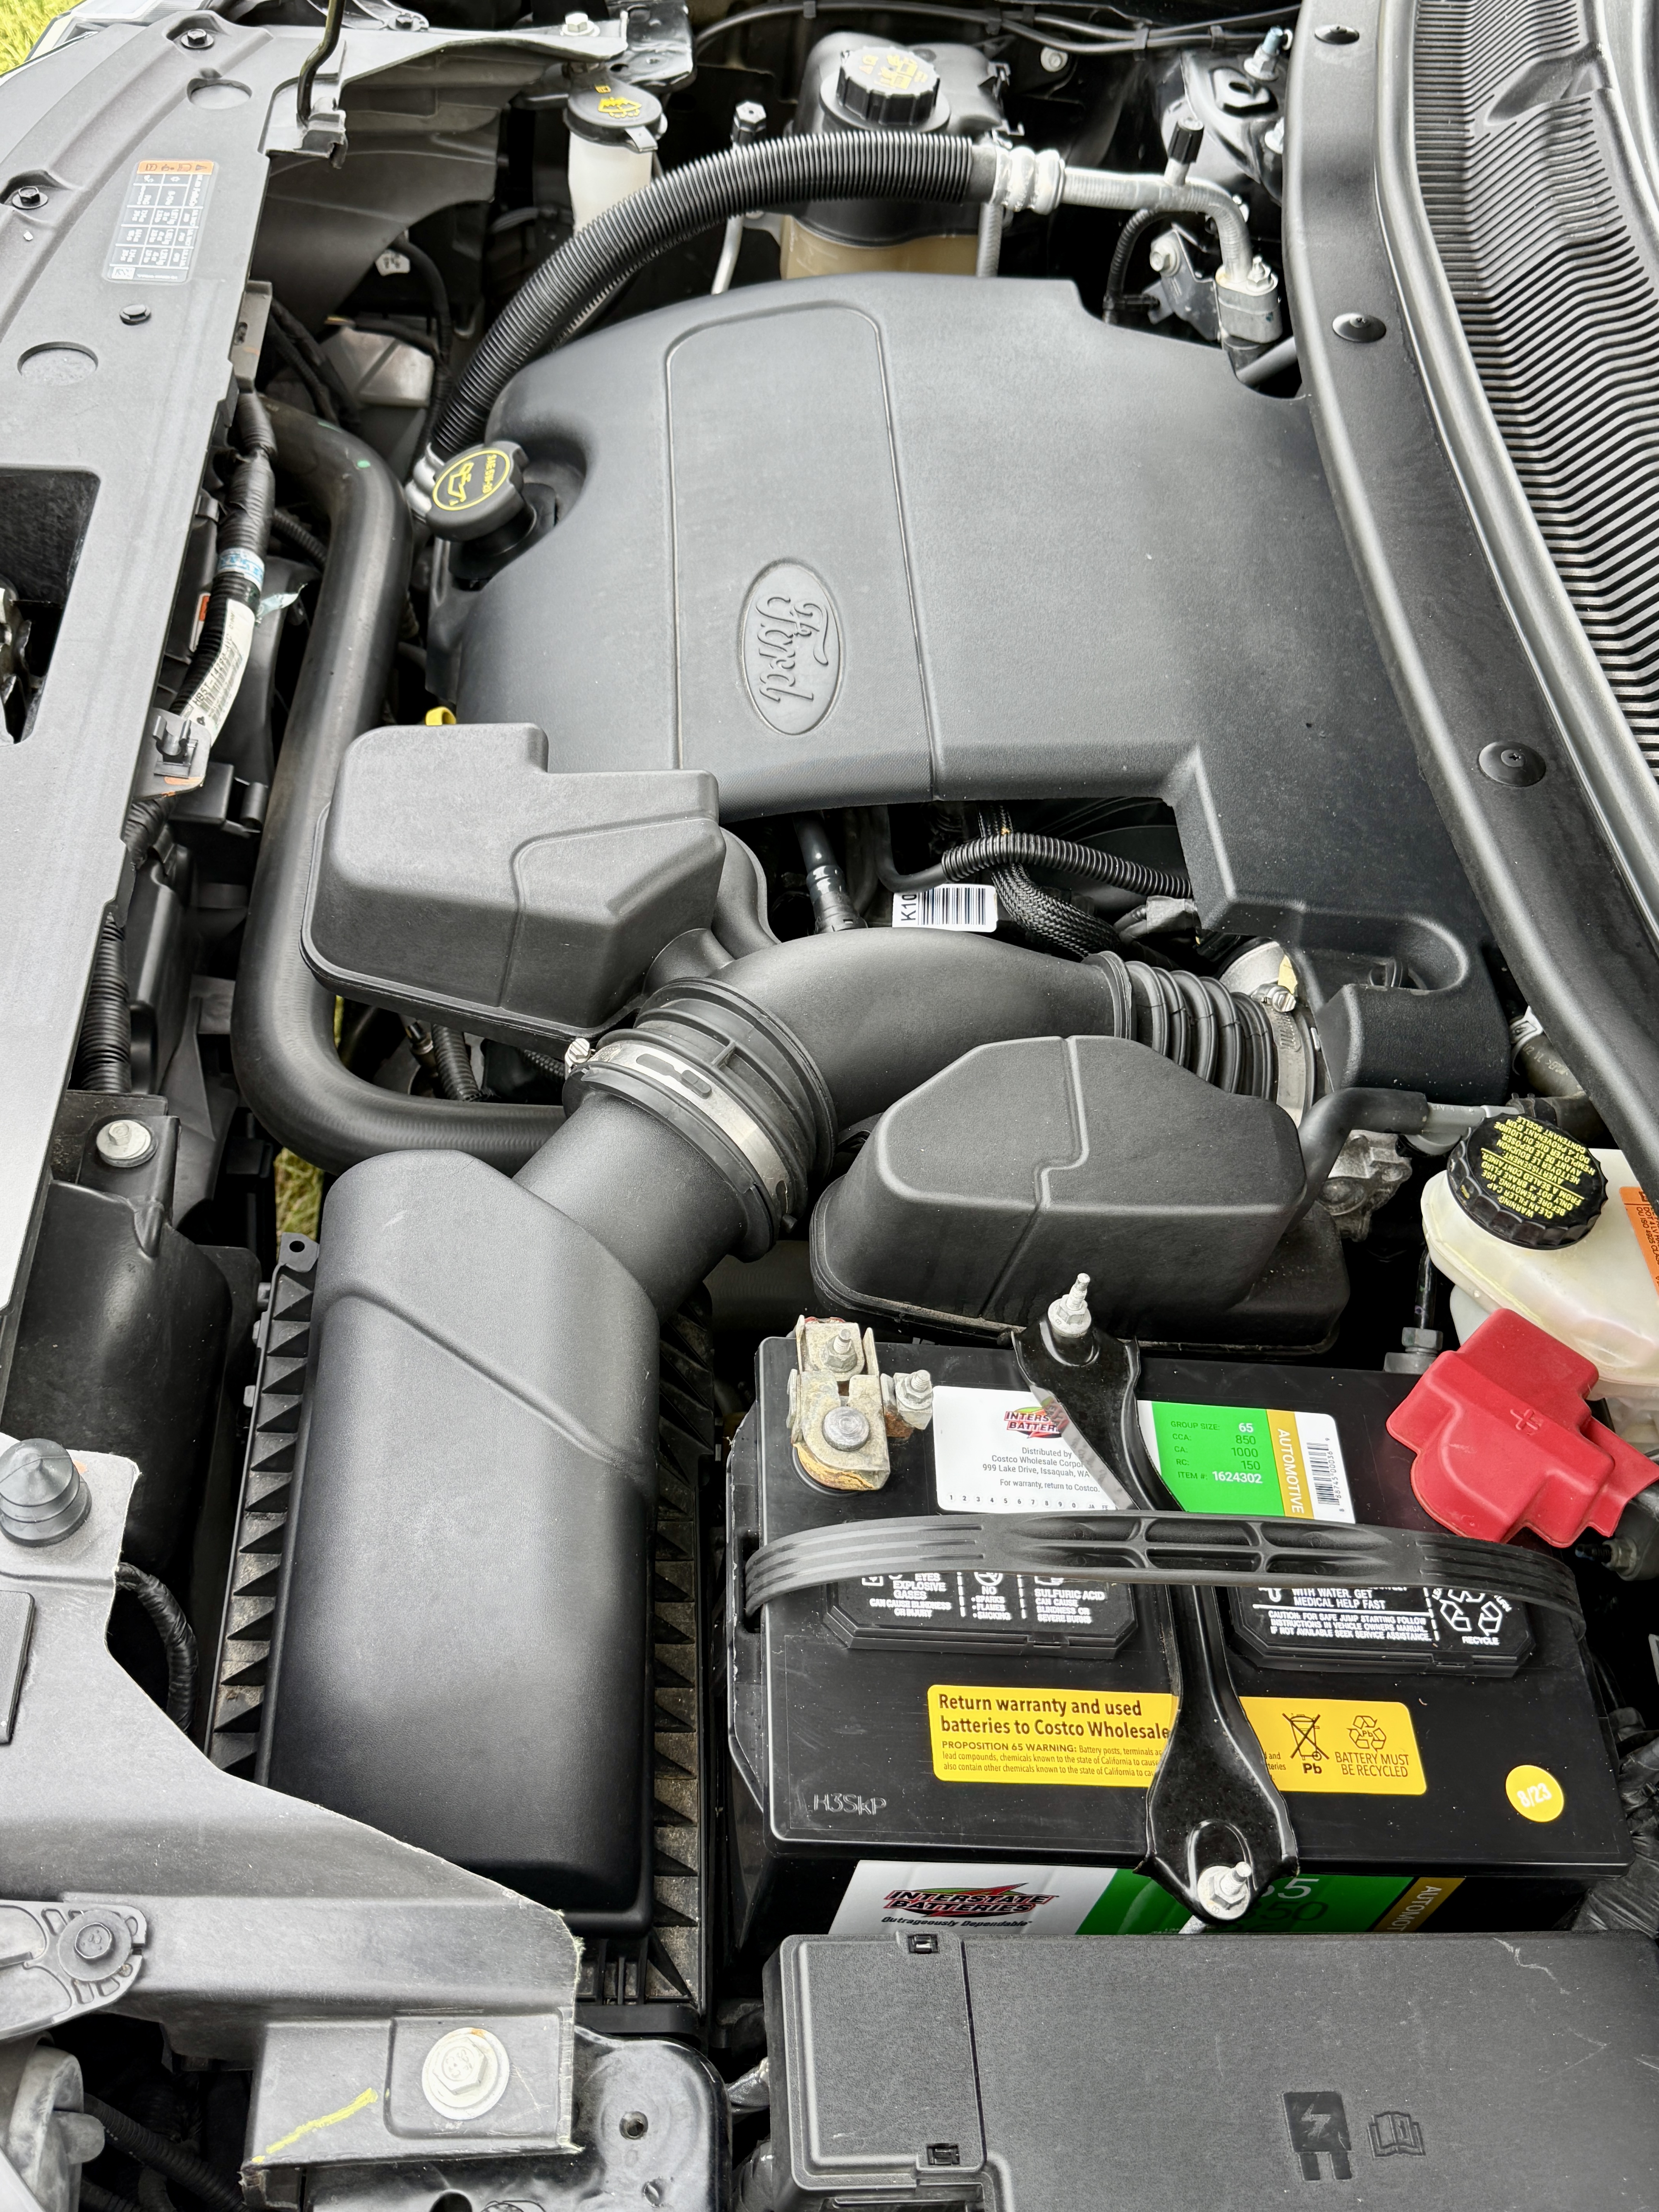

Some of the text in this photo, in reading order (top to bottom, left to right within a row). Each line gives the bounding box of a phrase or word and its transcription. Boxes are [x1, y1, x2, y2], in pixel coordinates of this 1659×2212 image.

[755, 596, 829, 703] Ford
[1494, 1121, 1523, 1139] LIQUIDE
[1516, 1116, 1586, 1154] CONTENANT SCELLE
[1523, 1135, 1534, 1145] DU
[1523, 1128, 1568, 1153] PROVENANT
[1534, 1140, 1550, 1152] QUE
[1501, 1132, 1582, 1176] AVANT DE LE DEPOSER.
[1574, 1152, 1590, 1164] DOT
[1481, 1161, 1503, 1176] FLUID
[1482, 1151, 1523, 1177] CONTAINER.
[1496, 1139, 1580, 1185] NETTOYER LE BOUCHON
[1502, 1151, 1564, 1185] AVERTISSEMENT:
[1481, 1170, 1497, 1182] USE
[1503, 1171, 1528, 1188] BRAKE
[1523, 1173, 1551, 1191] SEALED
[1487, 1183, 1553, 1219] CLEAN FILLER CAP
[1536, 1189, 1554, 1200] DOT
[1558, 1190, 1582, 1206] FROM
[1537, 1197, 1566, 1216] BEFORE
[1553, 1197, 1573, 1211] ONLY
[1643, 1207, 1654, 1219] DOT
[1636, 1207, 1656, 1244] OU ISO 4925
[1006, 1411, 1050, 1422] INTERS
[1008, 1422, 1058, 1432] BATTER
[1238, 1423, 1254, 1433] 65
[1235, 1435, 1256, 1445] 850
[1022, 1447, 1072, 1459] Distributed by
[1231, 1447, 1258, 1458] 1000
[1020, 1456, 1057, 1466] Wholesale
[1241, 1460, 1261, 1470] 150
[1018, 1465, 1039, 1475] Drive,
[1041, 1468, 1076, 1478] Issaquah,
[1178, 1471, 1198, 1479] ITEM
[1212, 1471, 1263, 1484] 1624302
[1278, 1428, 1305, 1514] AUTOMOTIVE
[1328, 1450, 1342, 1499] 88745 00036
[1013, 1481, 1043, 1489] warranty,
[1074, 1484, 1100, 1492] Costco.
[893, 1580, 946, 1592] EXPLOSIVE
[981, 1585, 997, 1595] NO
[893, 1589, 927, 1600] GASES
[1034, 1588, 1105, 1601] SULFURIC ACID
[1291, 1588, 1316, 1597] WITH
[1354, 1589, 1372, 1599] GET
[1293, 1596, 1385, 1609] MEDICAL HELP FAST
[1268, 1610, 1426, 1625] CAUTION: FOR SAFE JUMP STARTING FOLLOW
[1334, 1622, 1363, 1630] VEHICLE
[1462, 1636, 1501, 1646] RECYCLE
[939, 1694, 1142, 1717] Return warranty and used
[941, 1715, 1169, 1740] batteries to Costco Wholesale
[942, 1741, 1009, 1750] PROPOSITION
[1025, 1743, 1077, 1752] WARNING:
[1079, 1745, 1101, 1755] Battery
[943, 1751, 957, 1759] lead
[958, 1752, 998, 1762] compounds,
[1000, 1753, 1032, 1762] chemicals
[1033, 1753, 1055, 1762] known
[1064, 1755, 1075, 1763] the
[1093, 1756, 1100, 1764] of
[1101, 1756, 1132, 1765] California
[1268, 1752, 1281, 1760] and
[1334, 1752, 1409, 1765] BATTERY MUST
[944, 1762, 957, 1770] also
[984, 1763, 1001, 1772] other
[1003, 1764, 1035, 1772] chemicals
[1036, 1764, 1058, 1773] known
[1068, 1765, 1078, 1774] the
[1096, 1766, 1103, 1775] of
[1104, 1767, 1135, 1776] California
[1303, 1763, 1322, 1774] Pb
[1342, 1764, 1408, 1778] BE RECYCLED
[1516, 1782, 1552, 1808] 8/23
[890, 1890, 1050, 1905] INTERSTATE
[890, 1899, 1034, 1913] BATTERIES
[881, 1917, 959, 1927] Outrageously
